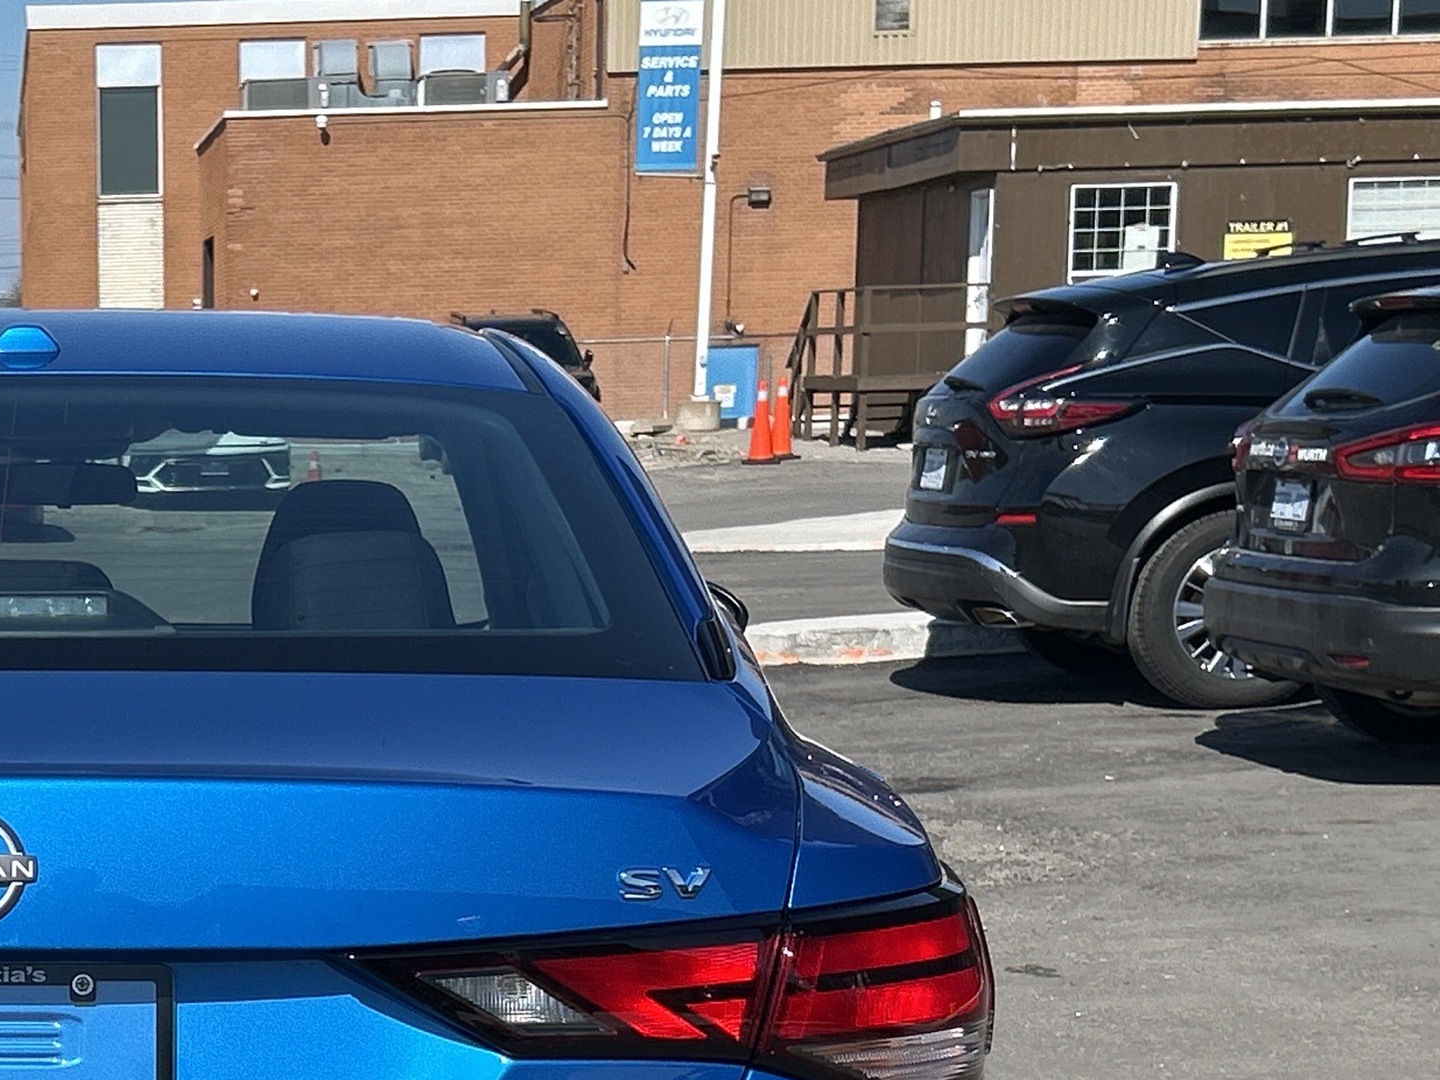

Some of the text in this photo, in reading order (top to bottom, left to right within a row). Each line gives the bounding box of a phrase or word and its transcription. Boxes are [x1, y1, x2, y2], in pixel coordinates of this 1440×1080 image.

[644, 28, 697, 37] HYUNDAI
[641, 56, 699, 69] SERVICE
[646, 85, 691, 98] PARTS
[652, 112, 684, 124] OPEN
[642, 126, 692, 138] 7 DAYS A
[651, 141, 683, 153] WEEK
[1229, 222, 1275, 232] TRAILER
[618, 867, 711, 899] SV
